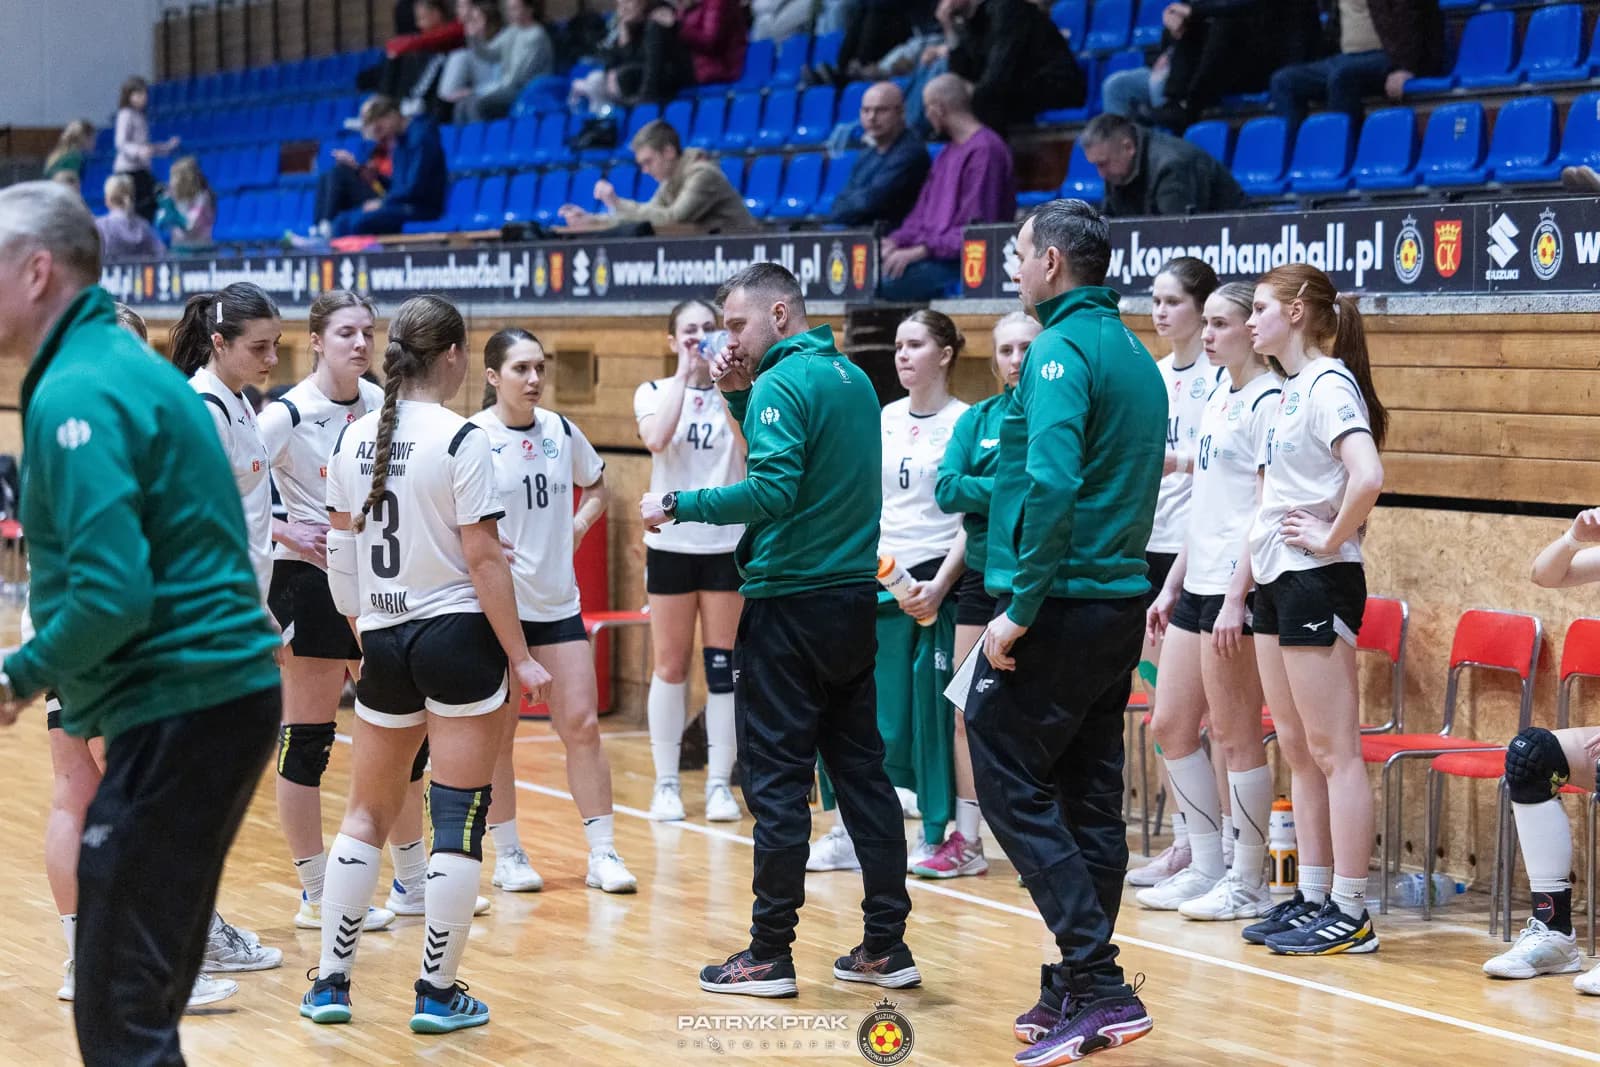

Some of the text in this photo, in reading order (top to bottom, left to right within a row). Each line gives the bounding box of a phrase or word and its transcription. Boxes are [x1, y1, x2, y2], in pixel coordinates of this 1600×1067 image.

[1437, 243, 1456, 271] CK
[1485, 269, 1519, 281] SUZUKI
[390, 441, 416, 461] AWF
[687, 423, 714, 450] 42
[1198, 434, 1212, 470] 13
[899, 457, 912, 490] 5
[522, 473, 549, 510] 18
[371, 490, 400, 579] 3
